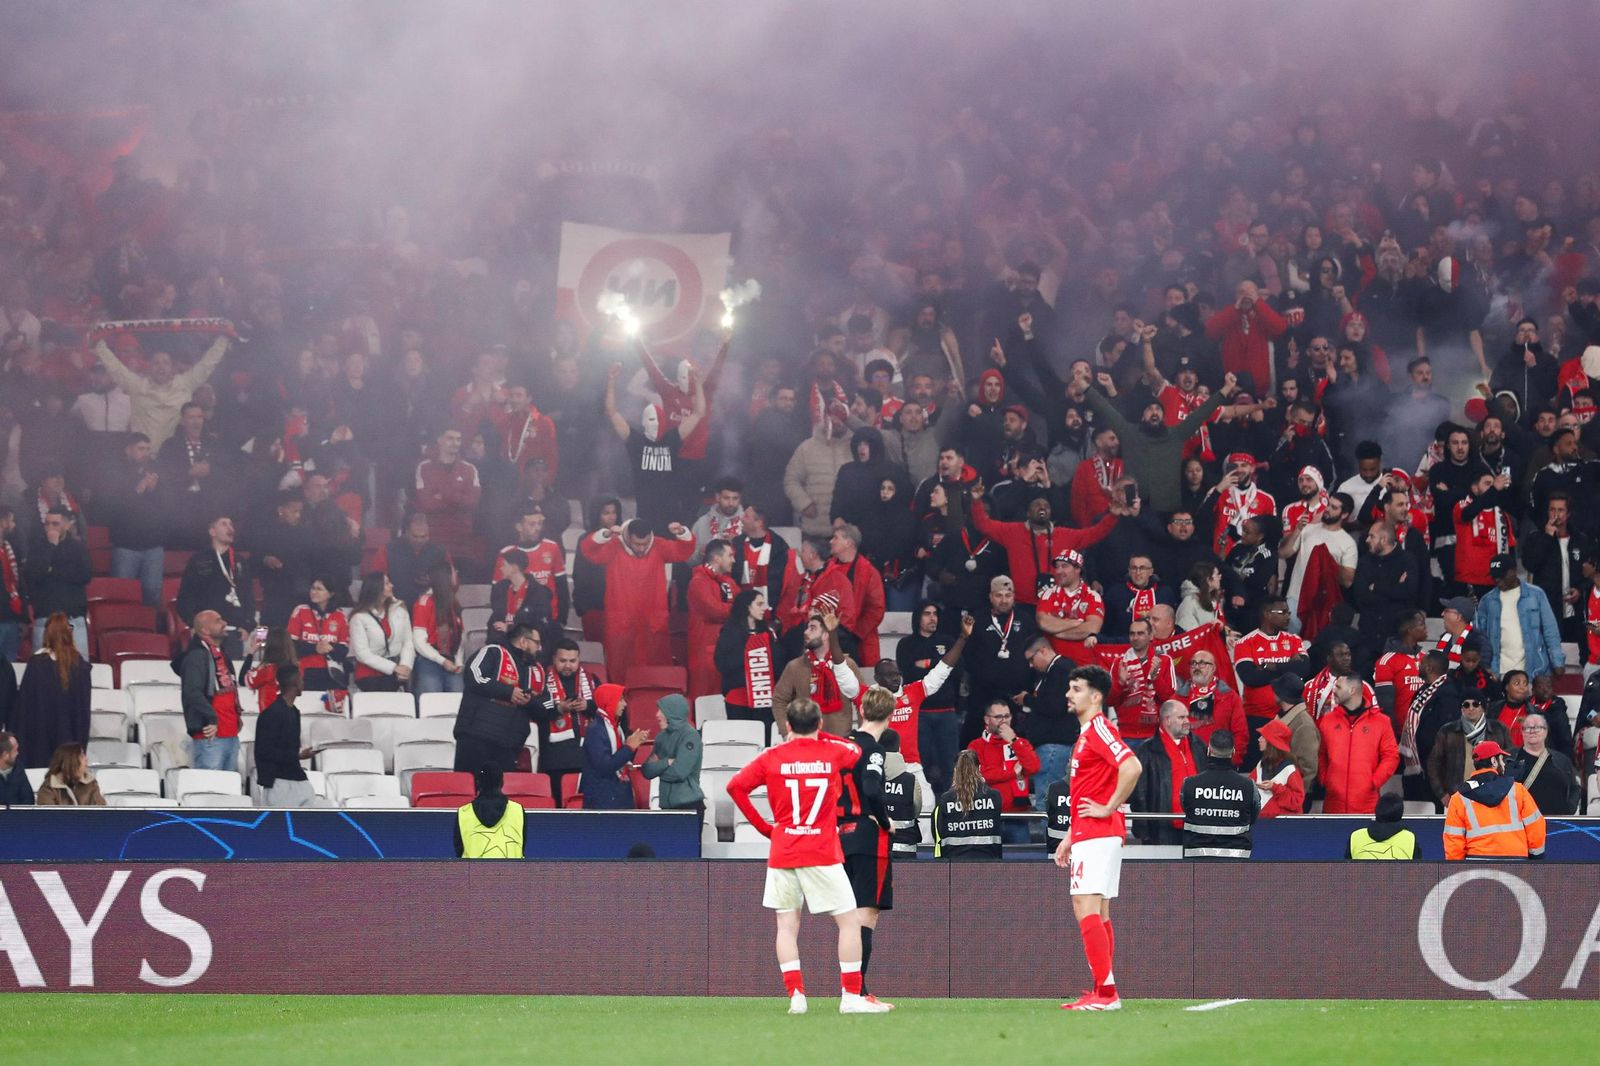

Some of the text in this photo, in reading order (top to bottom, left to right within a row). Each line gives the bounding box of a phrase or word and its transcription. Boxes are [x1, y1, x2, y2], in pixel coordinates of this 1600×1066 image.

[641, 455, 672, 471] UNUM
[1155, 635, 1192, 655] PRE
[748, 647, 773, 708] BENFICA
[1195, 786, 1244, 801] POLÍCIA
[785, 778, 828, 826] 17
[946, 798, 995, 813] POCIA
[1194, 808, 1240, 818] SPOTTERS
[947, 819, 994, 831] SPOTTERS
